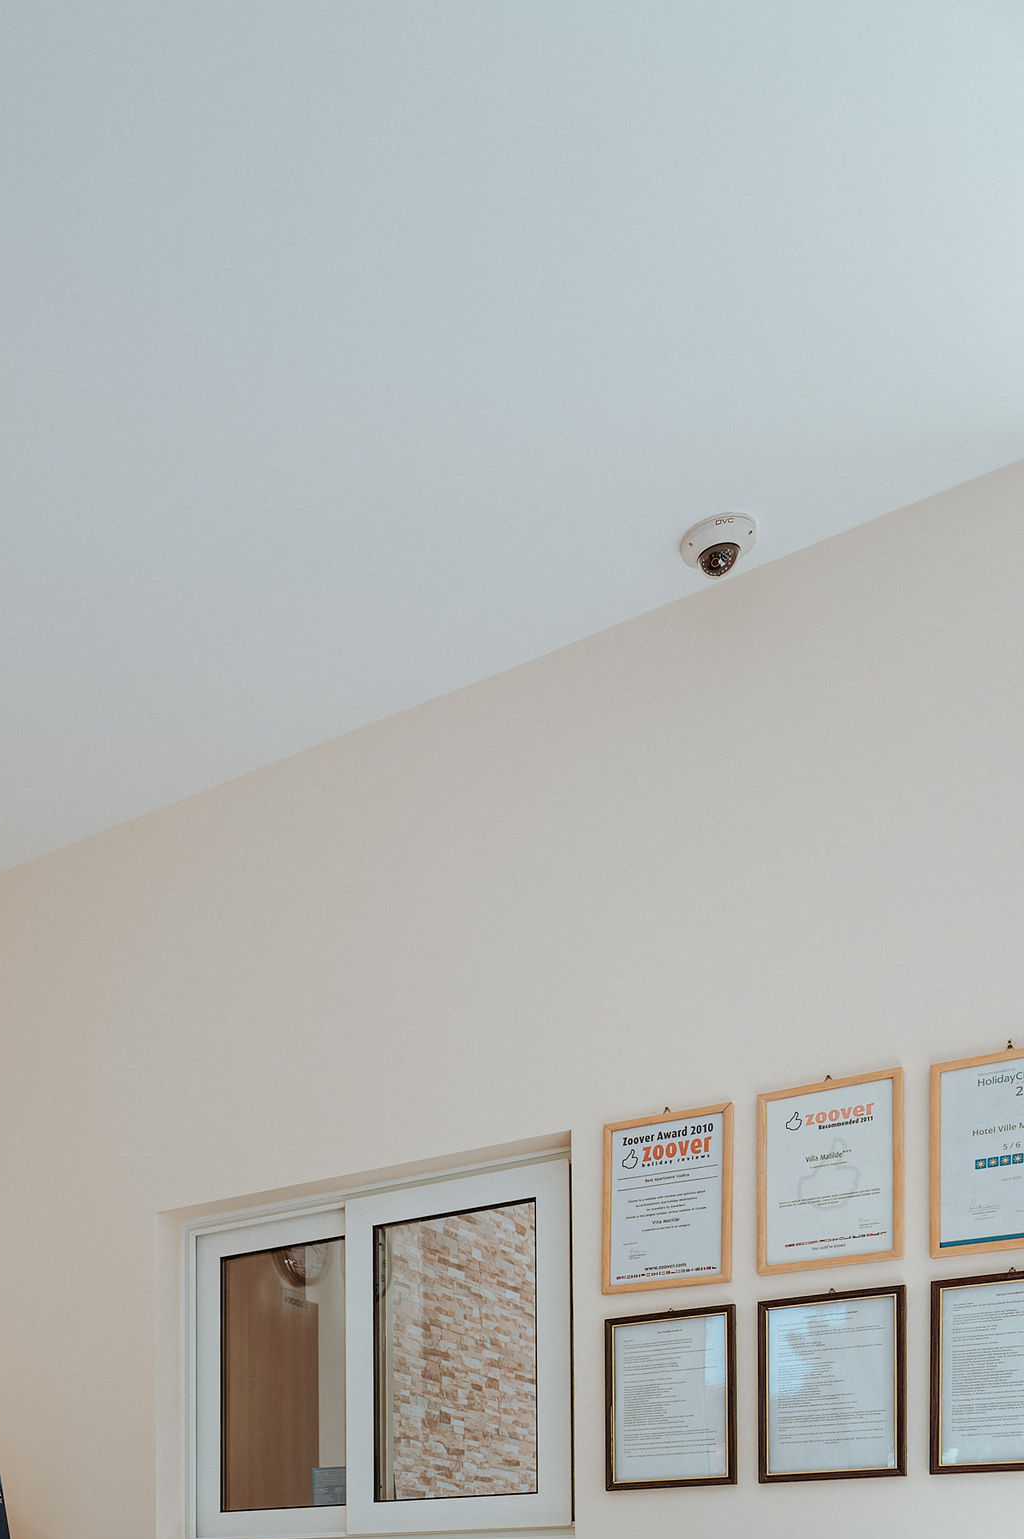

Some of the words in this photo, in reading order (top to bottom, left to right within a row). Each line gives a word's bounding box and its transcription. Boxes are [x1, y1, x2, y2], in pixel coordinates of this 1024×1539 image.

[805, 1102, 875, 1127] zoover
[818, 1118, 859, 1130] Recommended
[860, 1115, 874, 1123] 2011
[972, 1127, 996, 1136] Hotel
[998, 1123, 1017, 1133] Ville
[622, 1133, 655, 1146] Zoover
[657, 1126, 687, 1141] Award
[690, 1123, 714, 1136] 2010
[642, 1136, 712, 1162] zoover
[641, 1158, 673, 1168] holiday
[676, 1154, 710, 1163] reviews
[805, 1155, 819, 1163] Villa
